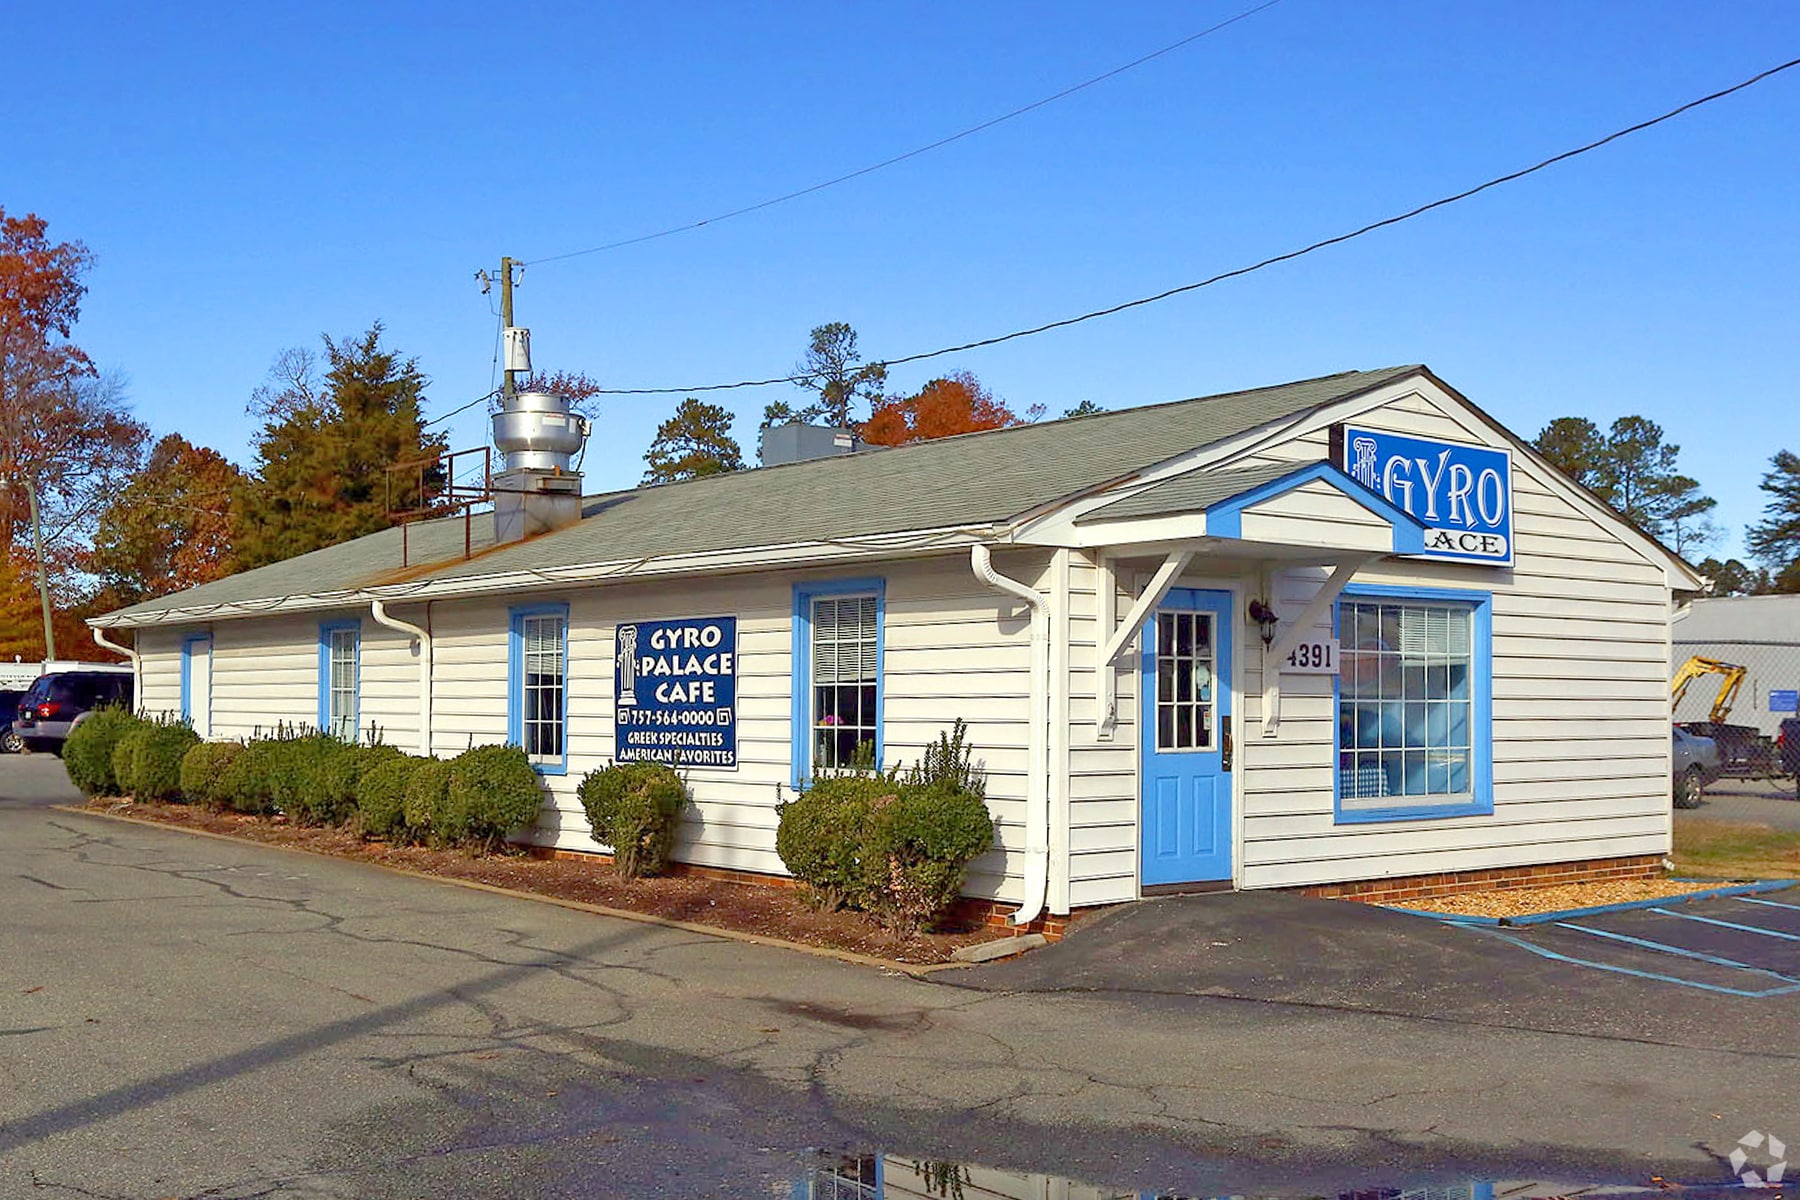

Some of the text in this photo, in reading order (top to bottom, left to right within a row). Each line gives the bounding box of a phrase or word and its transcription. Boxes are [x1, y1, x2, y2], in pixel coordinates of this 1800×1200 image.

[1383, 449, 1506, 530] GYRO
[1425, 532, 1499, 554] ACE
[651, 626, 721, 649] GYRO
[642, 653, 732, 676] PALACE
[1287, 644, 1331, 667] 4391
[655, 682, 714, 703] CAFE
[631, 710, 714, 725] 757-564-0000
[628, 732, 723, 746] GREEK SPECIALTIES
[619, 747, 672, 761] AMERICAN
